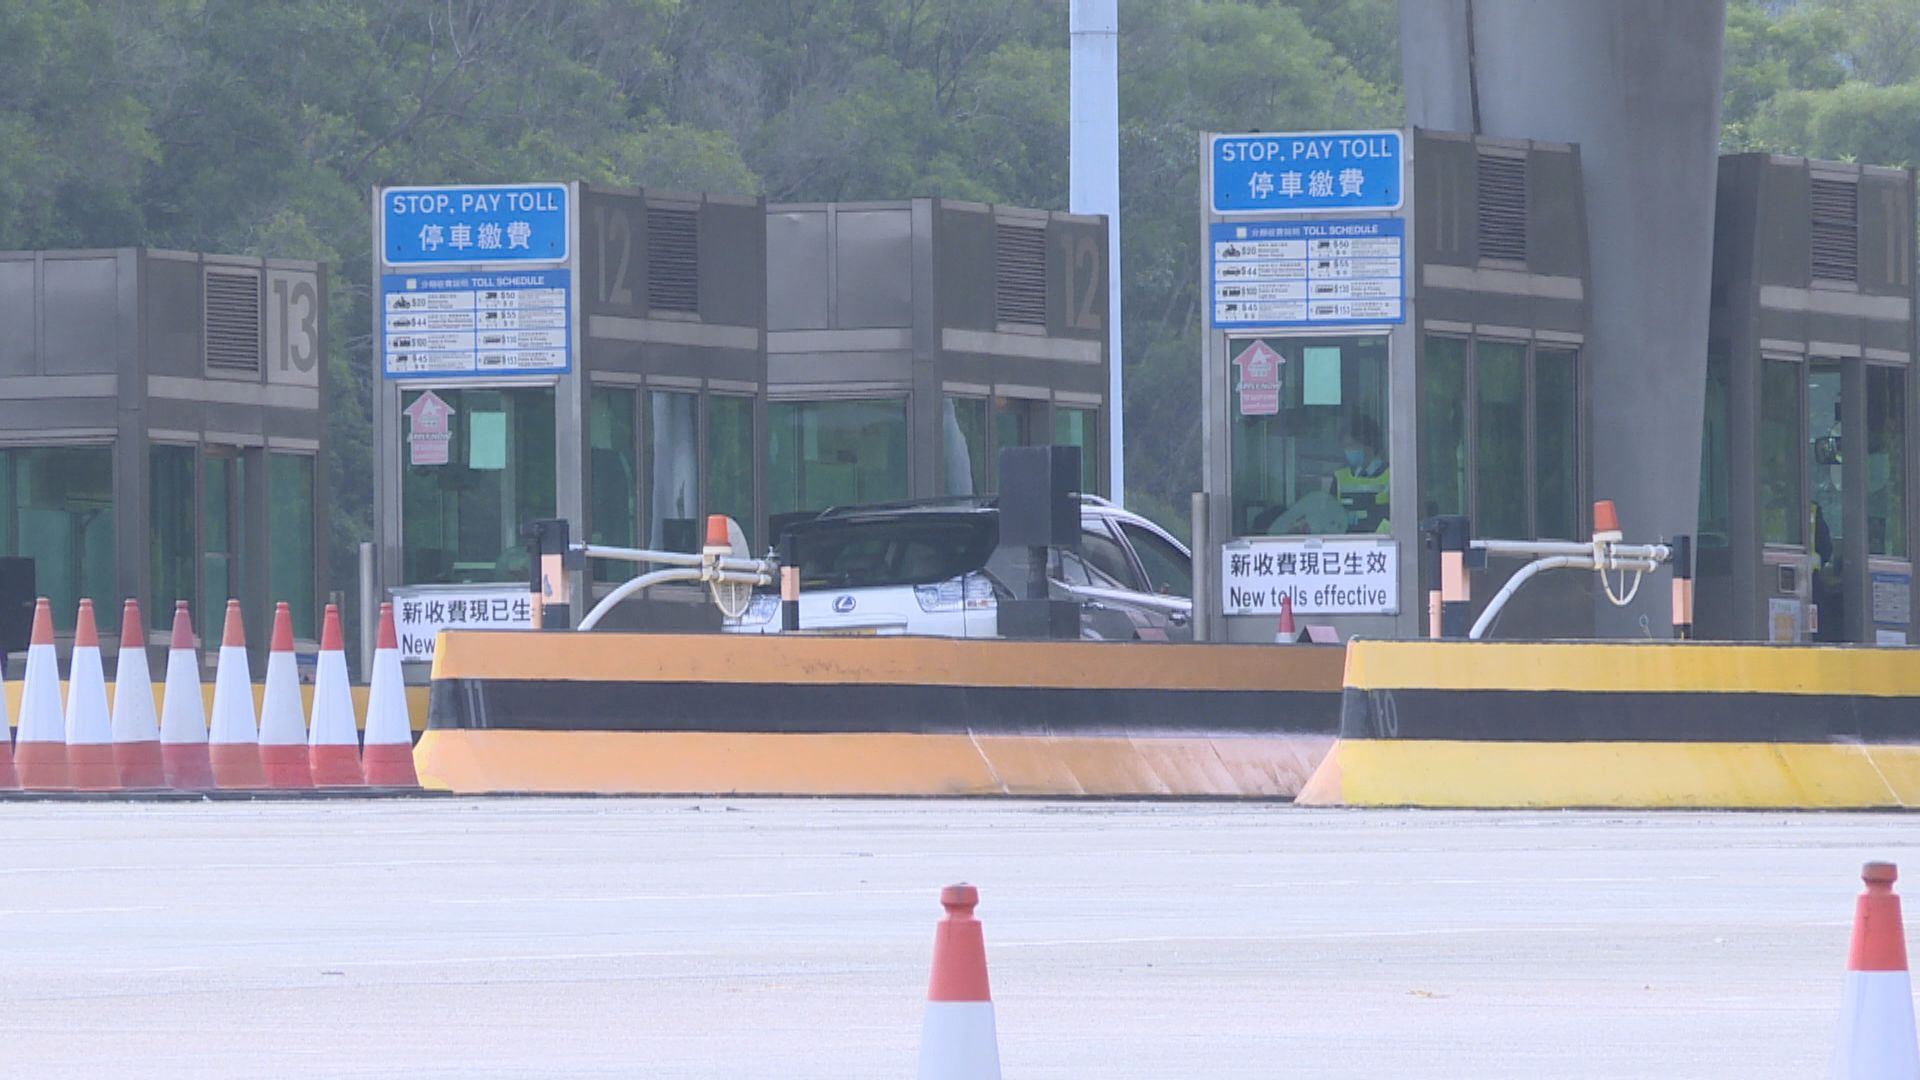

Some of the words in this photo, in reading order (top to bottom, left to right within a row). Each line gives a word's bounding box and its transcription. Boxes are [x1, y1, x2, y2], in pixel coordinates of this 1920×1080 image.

[1292, 140, 1334, 160] PAY
[1339, 137, 1392, 158] TOLL
[1248, 168, 1365, 199] 停車繳費
[461, 193, 502, 213] PAY
[506, 192, 559, 212] TOLL
[418, 221, 532, 252] 停車繳費
[1303, 226, 1327, 235] TOLL
[1329, 224, 1379, 235] SCHEDULE
[594, 206, 632, 305] 12
[471, 278, 495, 287] TOLL
[496, 276, 545, 286] SCHEDULE
[1061, 232, 1101, 329] 12
[274, 279, 318, 373] 13
[1230, 550, 1387, 578] 新收費現已生效
[1230, 587, 1265, 608] New
[1271, 584, 1308, 607] tolls
[1314, 583, 1387, 606] effective
[402, 633, 435, 656] New
